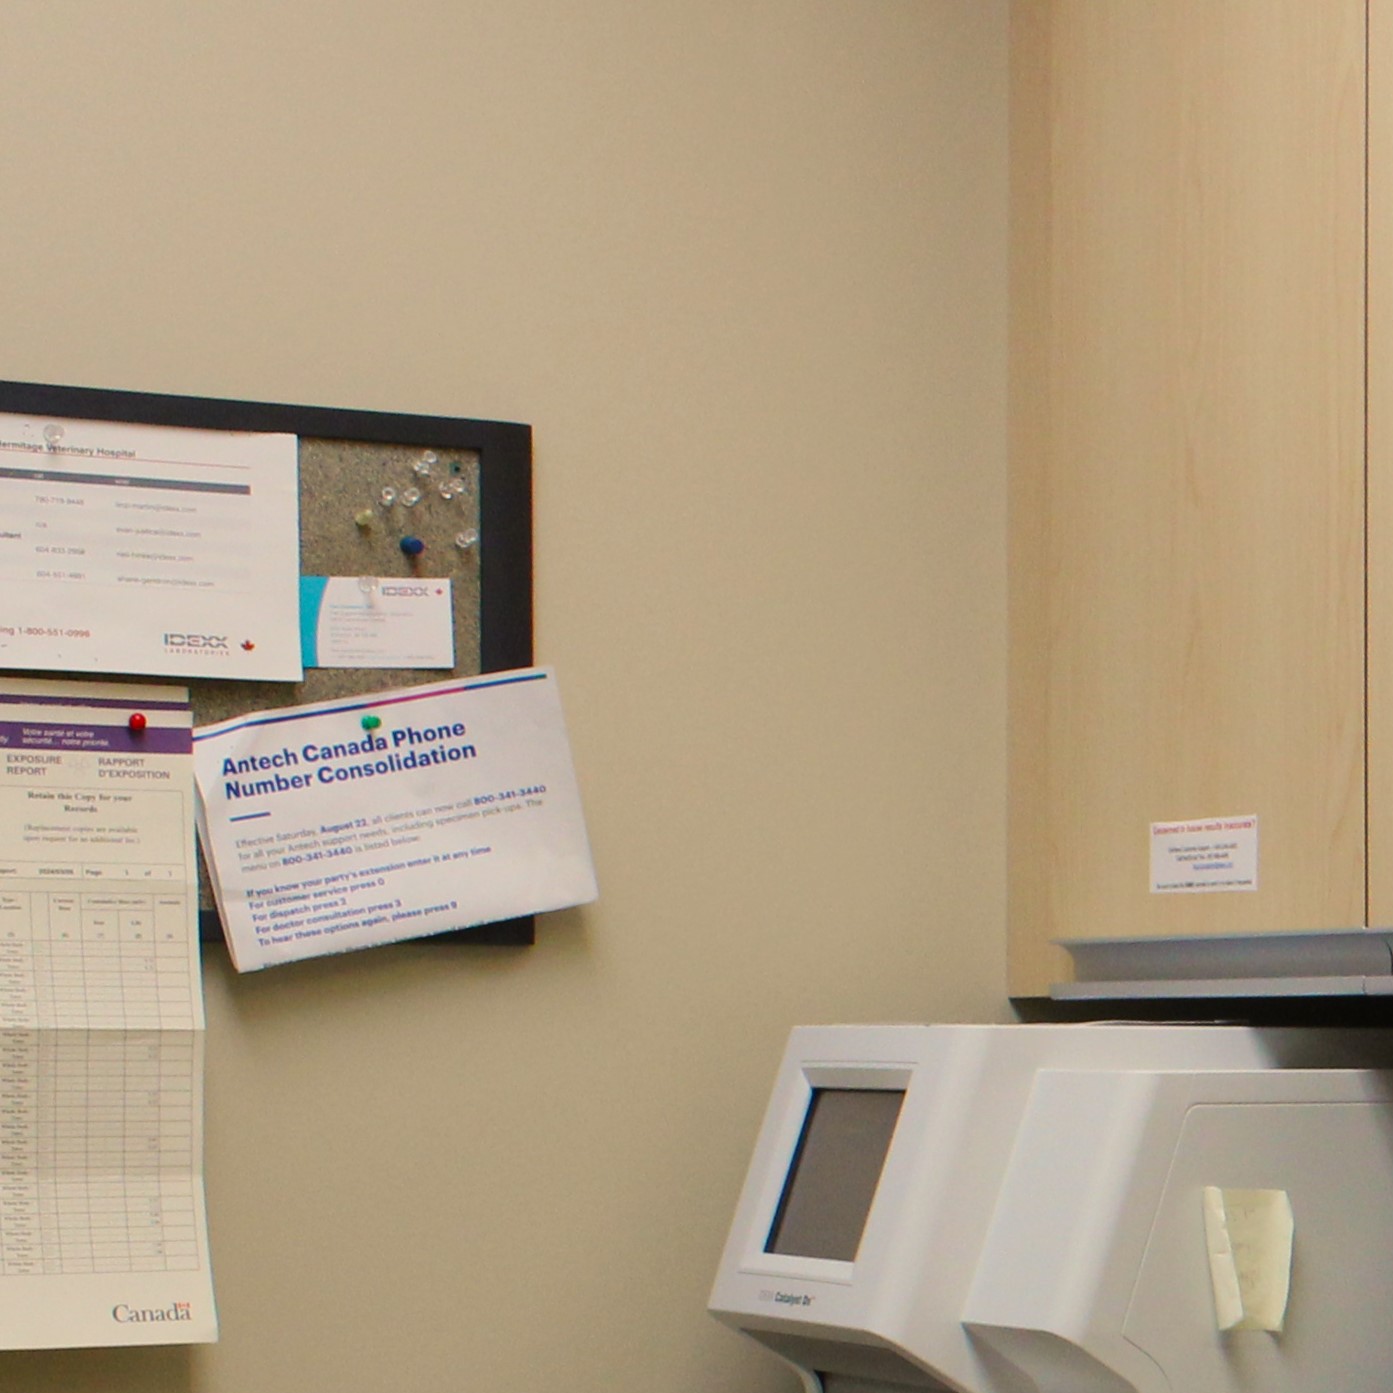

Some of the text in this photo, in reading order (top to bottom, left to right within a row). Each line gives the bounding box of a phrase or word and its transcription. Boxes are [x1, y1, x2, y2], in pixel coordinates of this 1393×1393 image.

[47, 443, 94, 457] Veterinary
[96, 447, 136, 459] Hospital
[382, 586, 429, 597] IDEXX
[164, 633, 228, 649] IDEXX
[222, 722, 466, 776] Antech Canada Phone
[7, 754, 145, 767] EXPOSURE RAPPORT
[6, 765, 170, 779] REPORT D'EXPOSITION
[225, 745, 477, 800] Number Consolidation
[246, 846, 491, 898] If you know your party's extension enter it at any time
[249, 901, 264, 910] For
[266, 893, 310, 907] customer
[312, 885, 348, 898] service
[350, 880, 376, 893] press
[252, 913, 267, 922] For
[269, 904, 311, 919] dispatch
[312, 900, 339, 913] press
[255, 925, 270, 935] For
[272, 918, 305, 932] doctor
[306, 907, 366, 925] consultation
[367, 901, 394, 914] press
[774, 1291, 802, 1306] Catalyst
[112, 1302, 192, 1323] Canada
